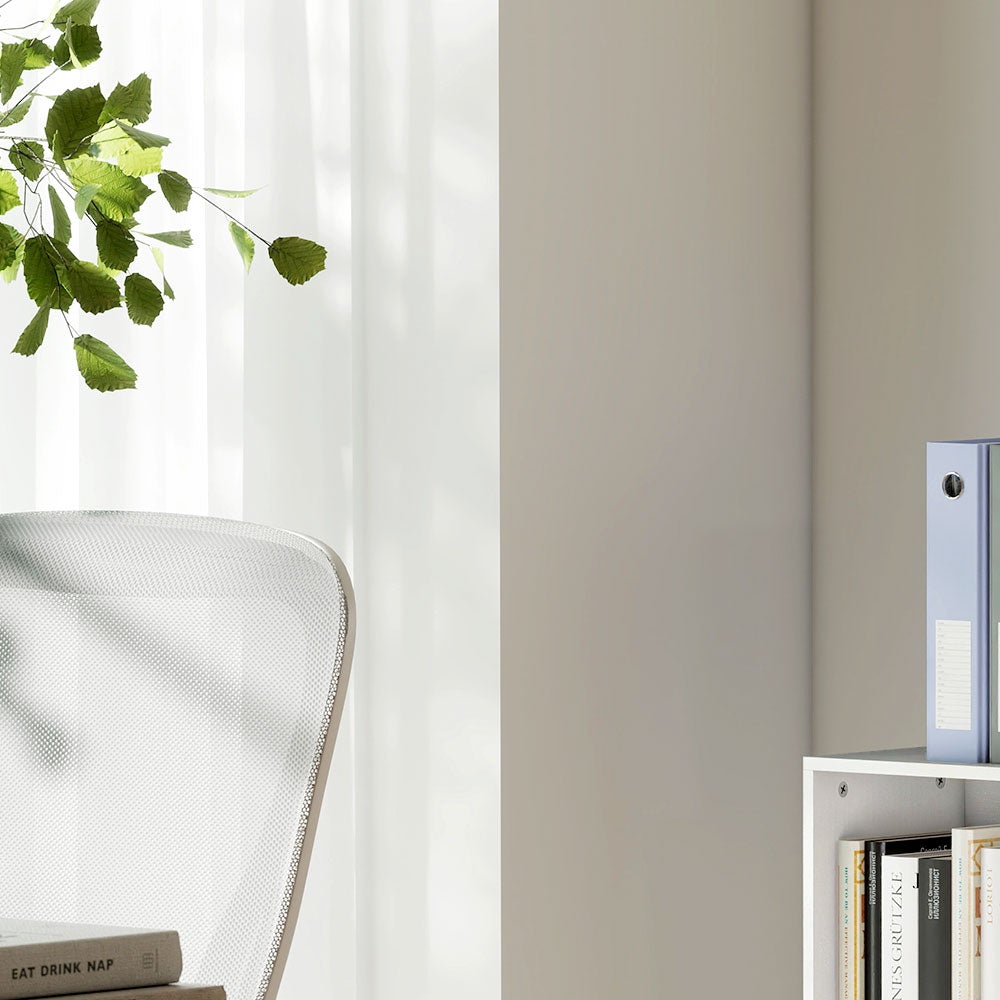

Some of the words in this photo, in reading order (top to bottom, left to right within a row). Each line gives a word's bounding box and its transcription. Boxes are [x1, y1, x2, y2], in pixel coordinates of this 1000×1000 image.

[889, 871, 903, 962] GRÜTZKE
[11, 966, 36, 980] EAT
[40, 963, 82, 977] DRINK
[87, 959, 115, 973] NAP
